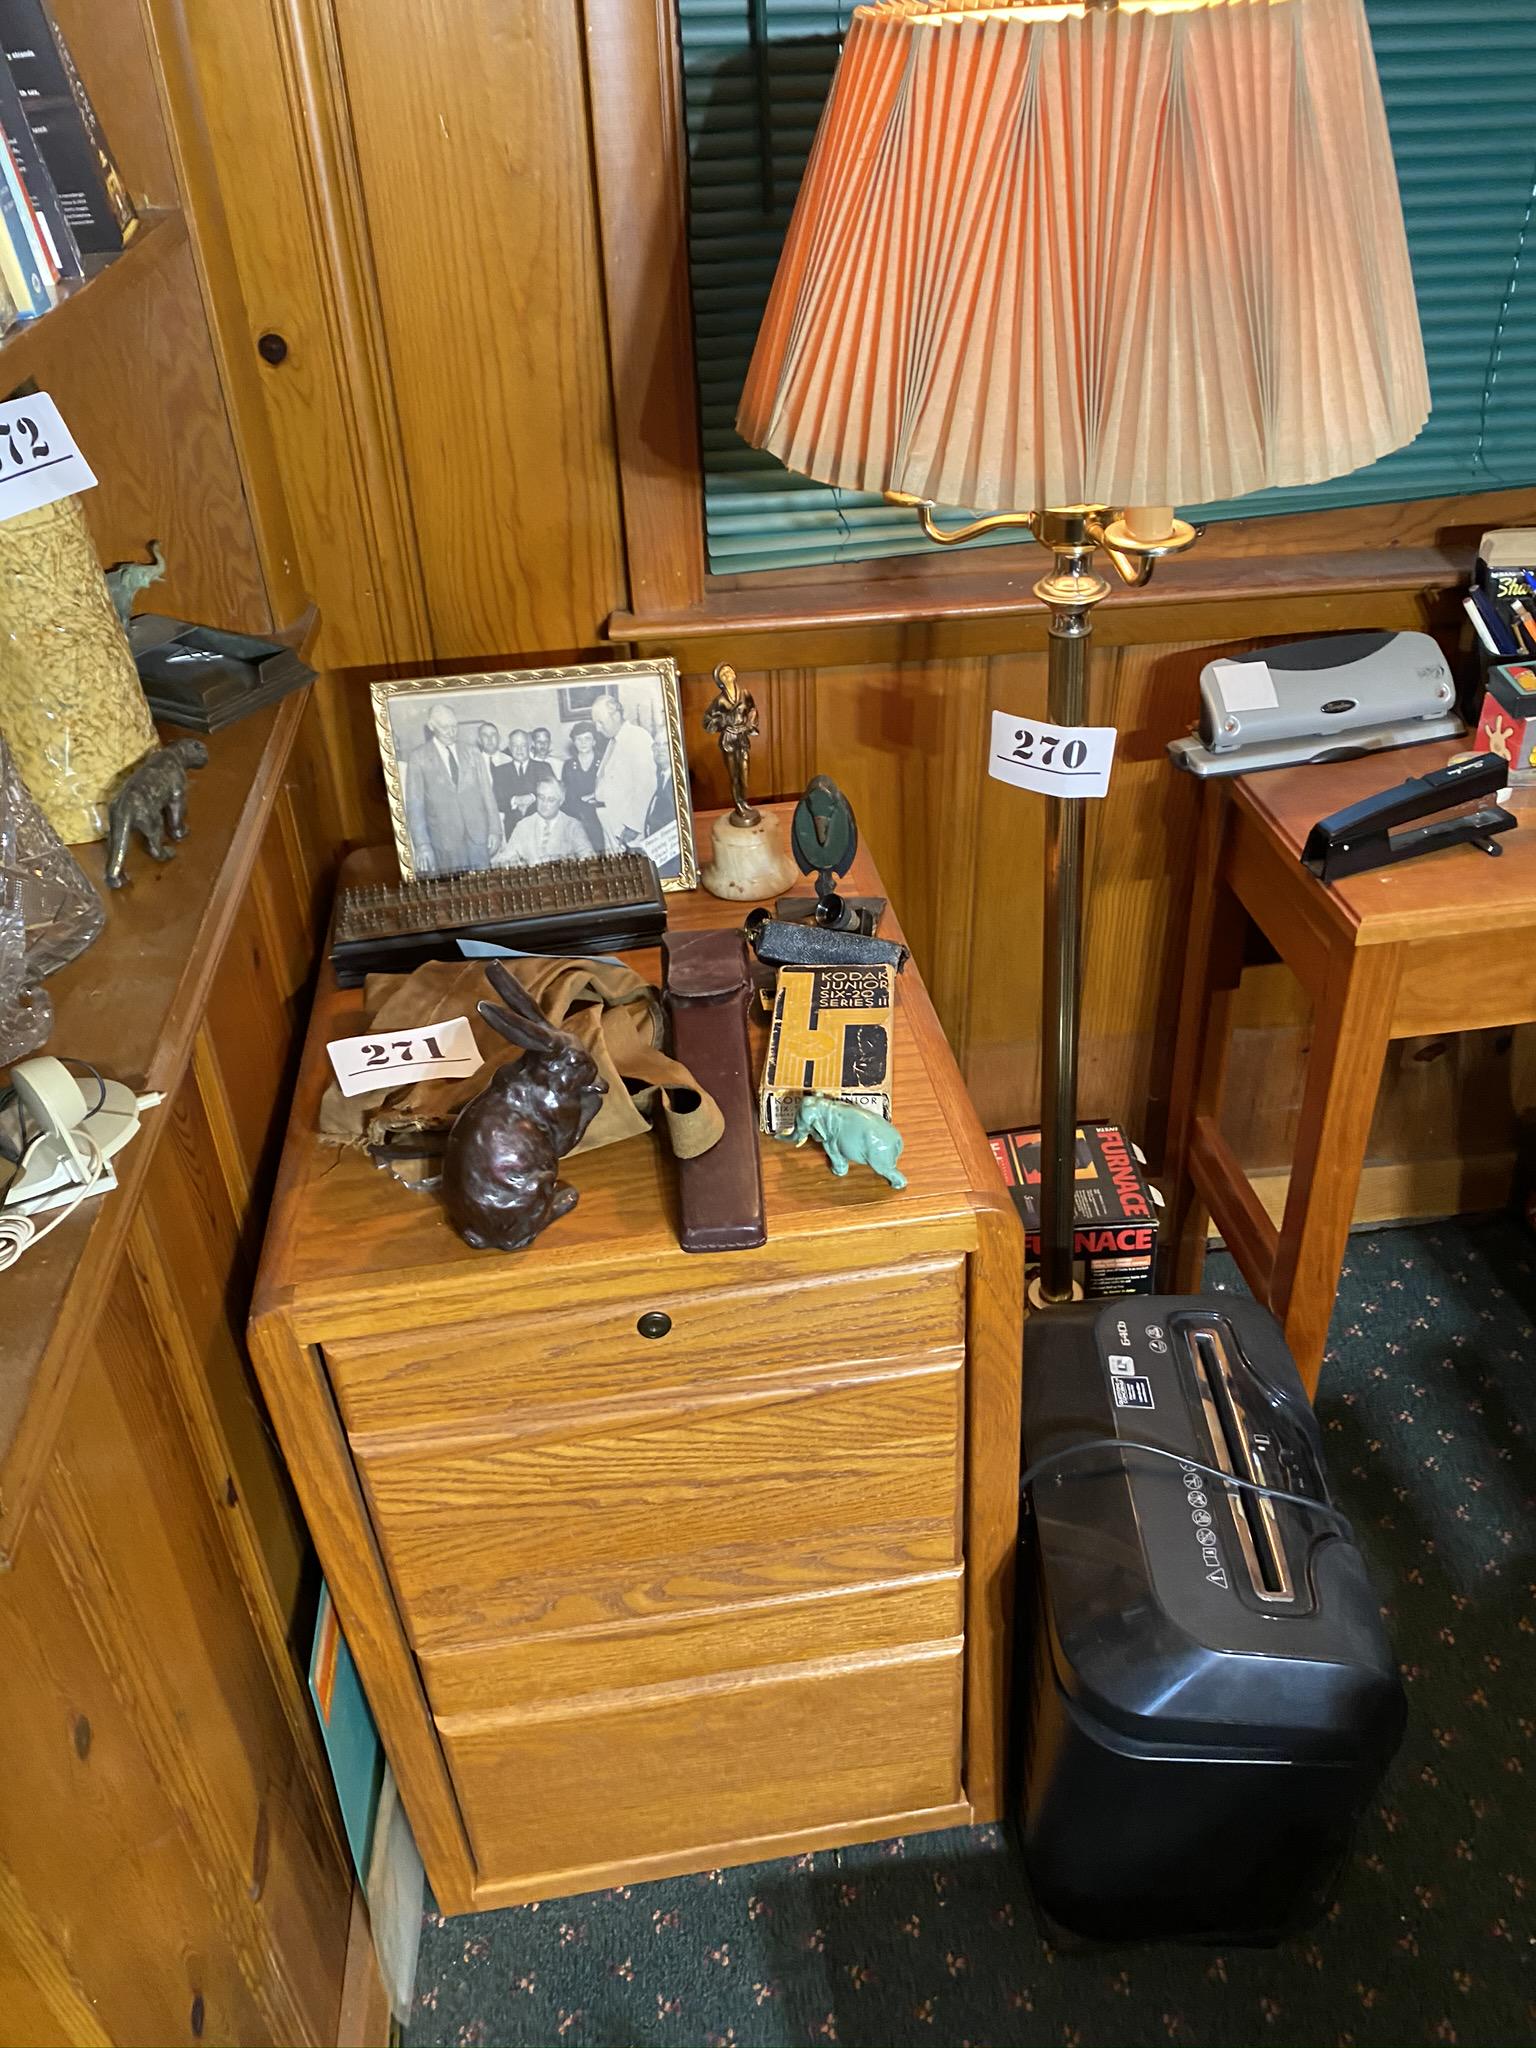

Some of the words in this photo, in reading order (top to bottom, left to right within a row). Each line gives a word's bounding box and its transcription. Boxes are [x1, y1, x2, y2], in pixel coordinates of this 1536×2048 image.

[0, 417, 49, 471] 72
[1012, 730, 1088, 769] 270
[820, 980, 888, 990] JUNIOR
[821, 971, 888, 981] KODAK
[819, 998, 874, 1007] SERIES
[820, 989, 875, 998] SIX-20
[361, 1037, 446, 1067] 271
[1096, 1131, 1150, 1217] FURNACE
